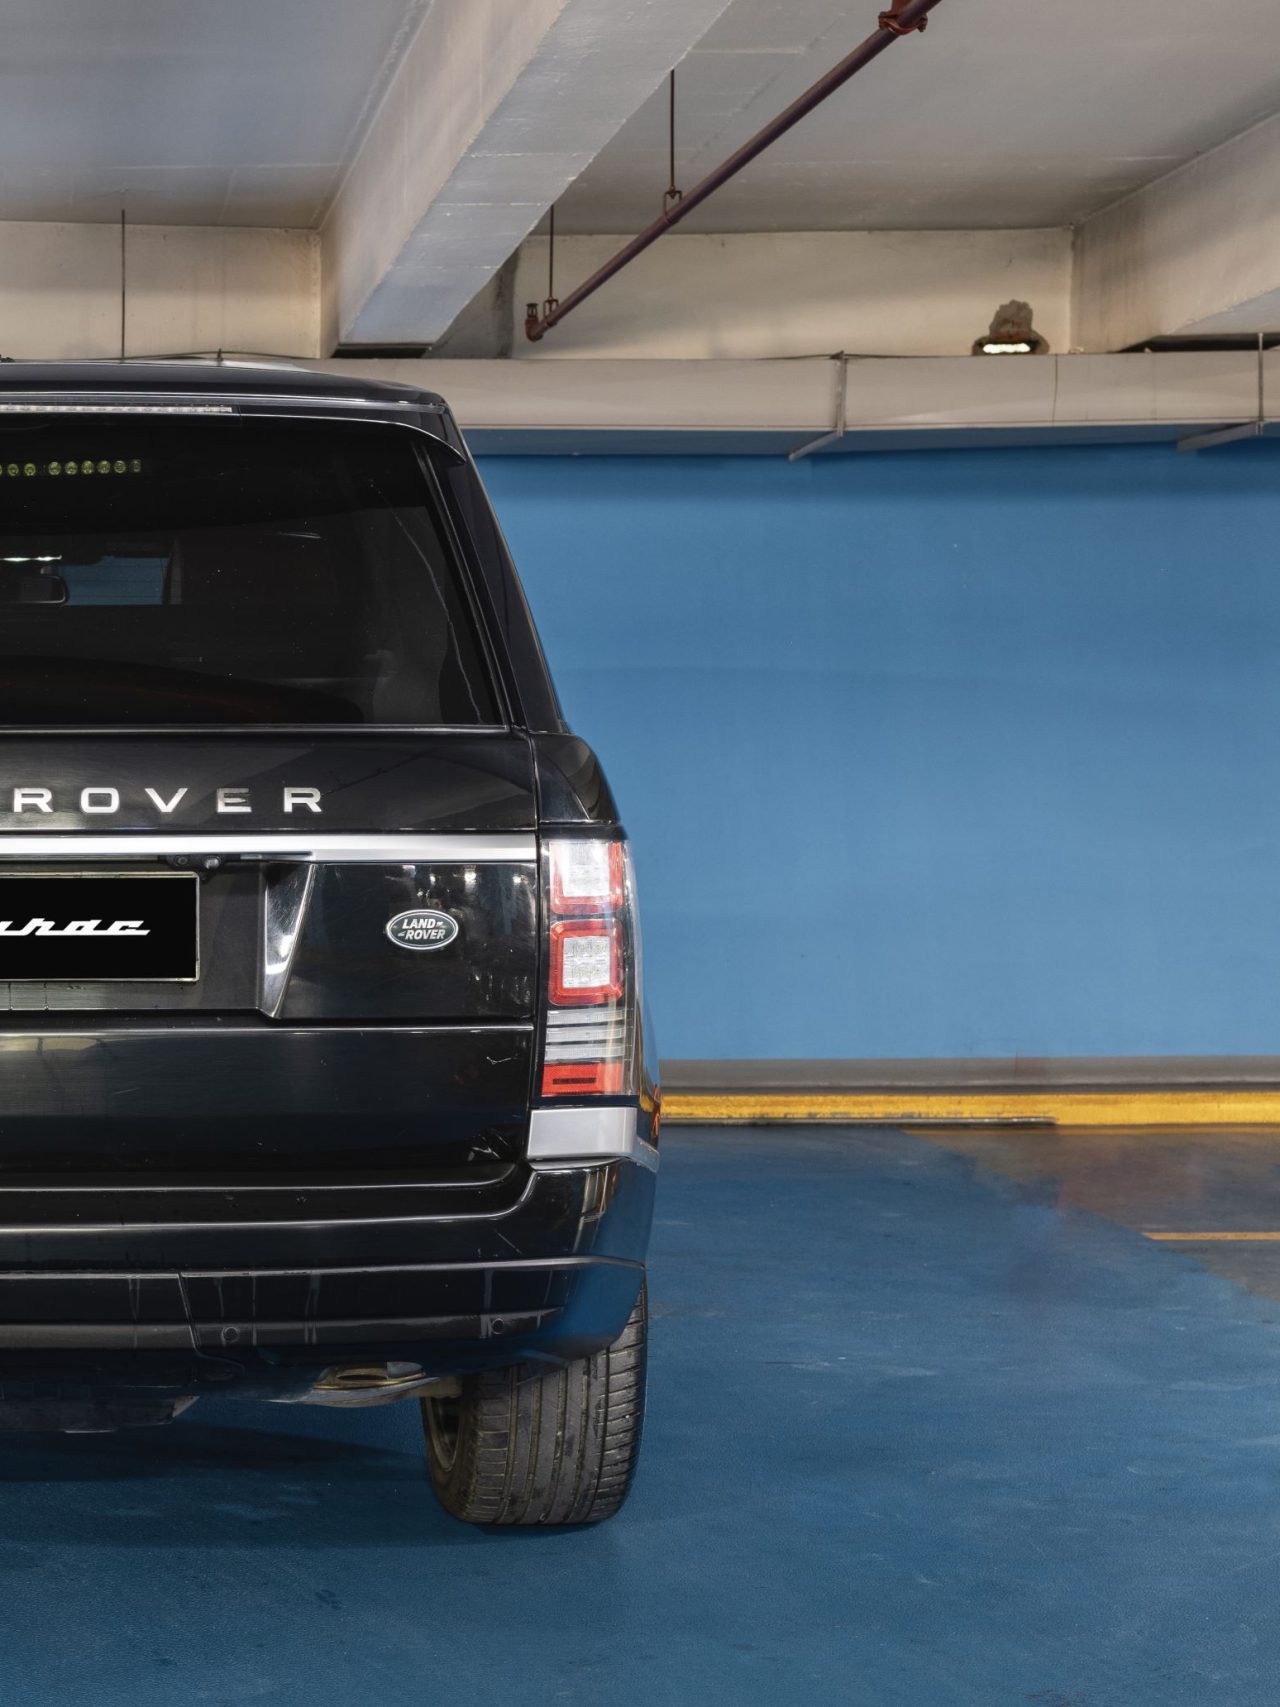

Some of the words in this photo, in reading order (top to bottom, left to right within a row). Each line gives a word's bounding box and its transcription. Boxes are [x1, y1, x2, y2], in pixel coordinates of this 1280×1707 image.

[14, 787, 323, 812] ROVER
[402, 918, 436, 929] LAND
[405, 929, 446, 940] ROVER
